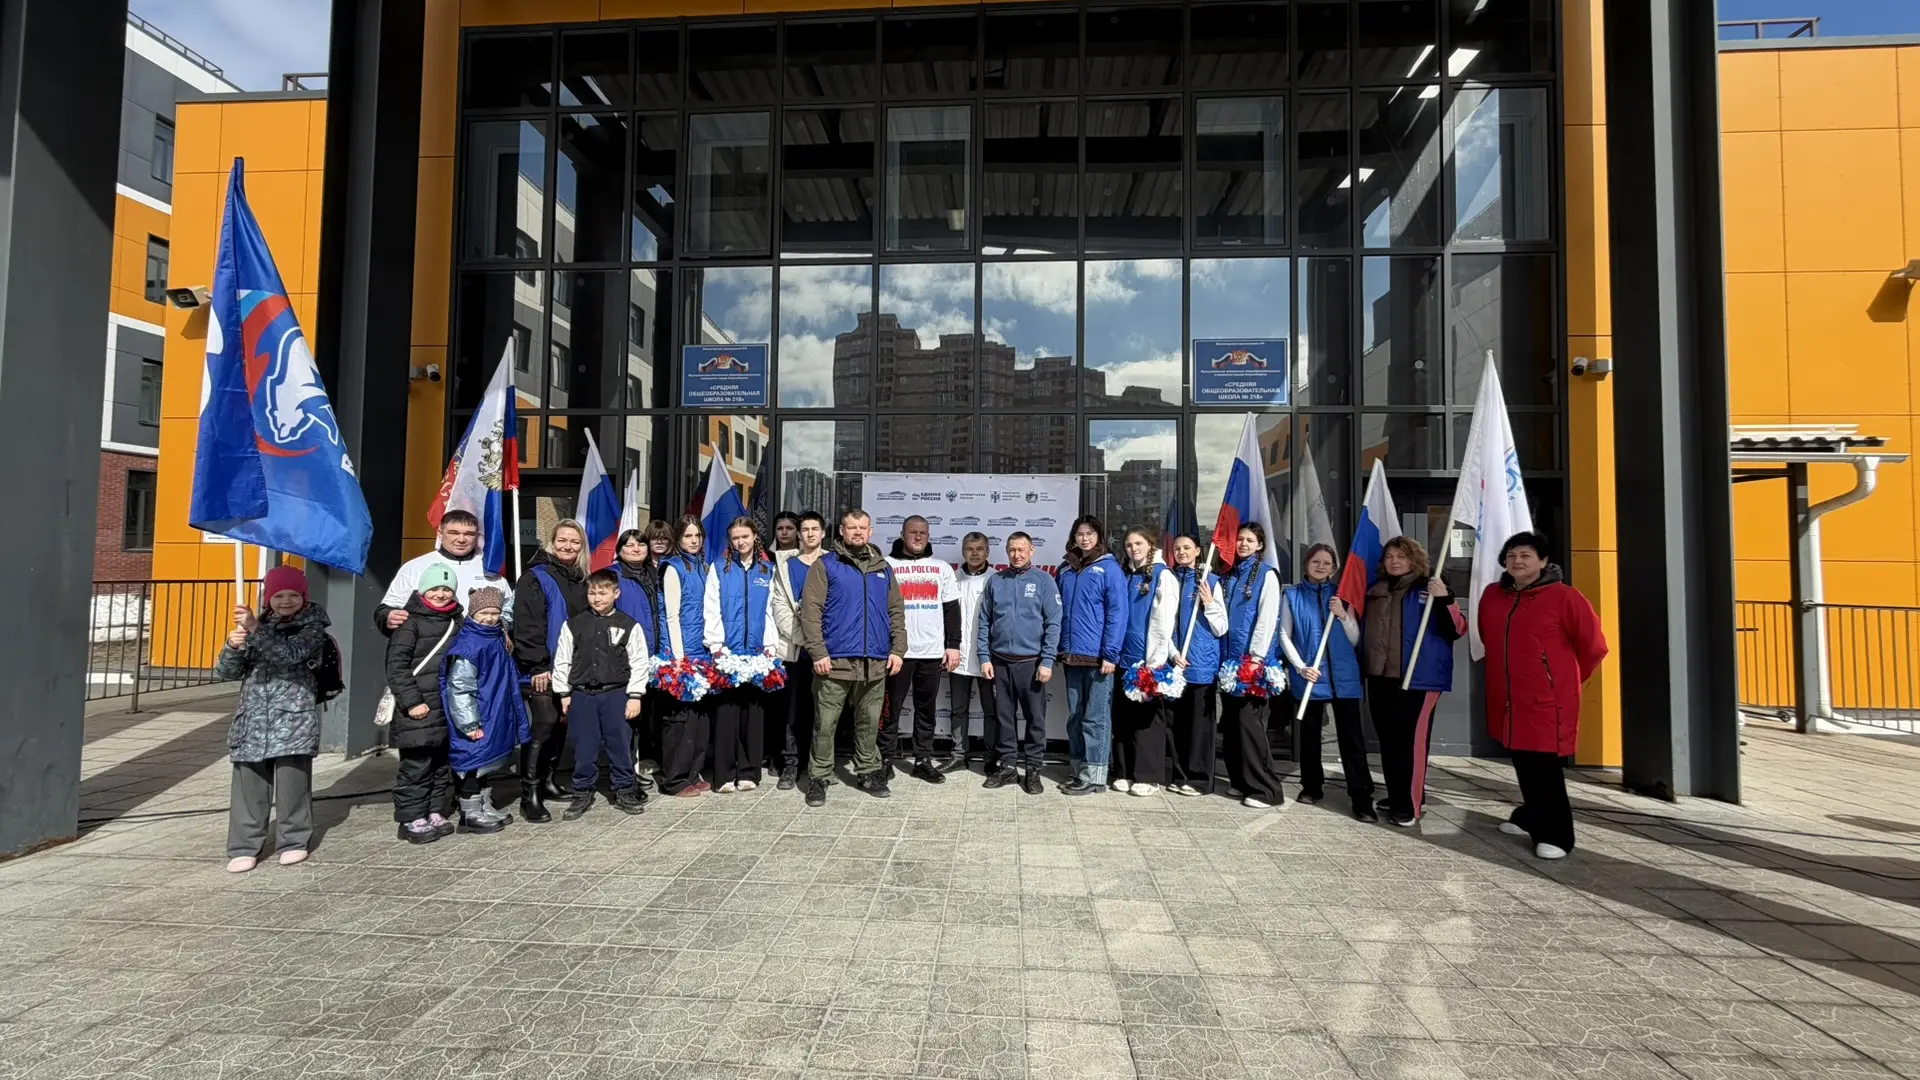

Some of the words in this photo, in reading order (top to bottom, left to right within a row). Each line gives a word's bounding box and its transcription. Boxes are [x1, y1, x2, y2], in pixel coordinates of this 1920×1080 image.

[1460, 540, 1475, 548] ВХ
[893, 565, 910, 575] ИЛА
[911, 565, 940, 574] РОССИИ
[607, 626, 626, 647] V
